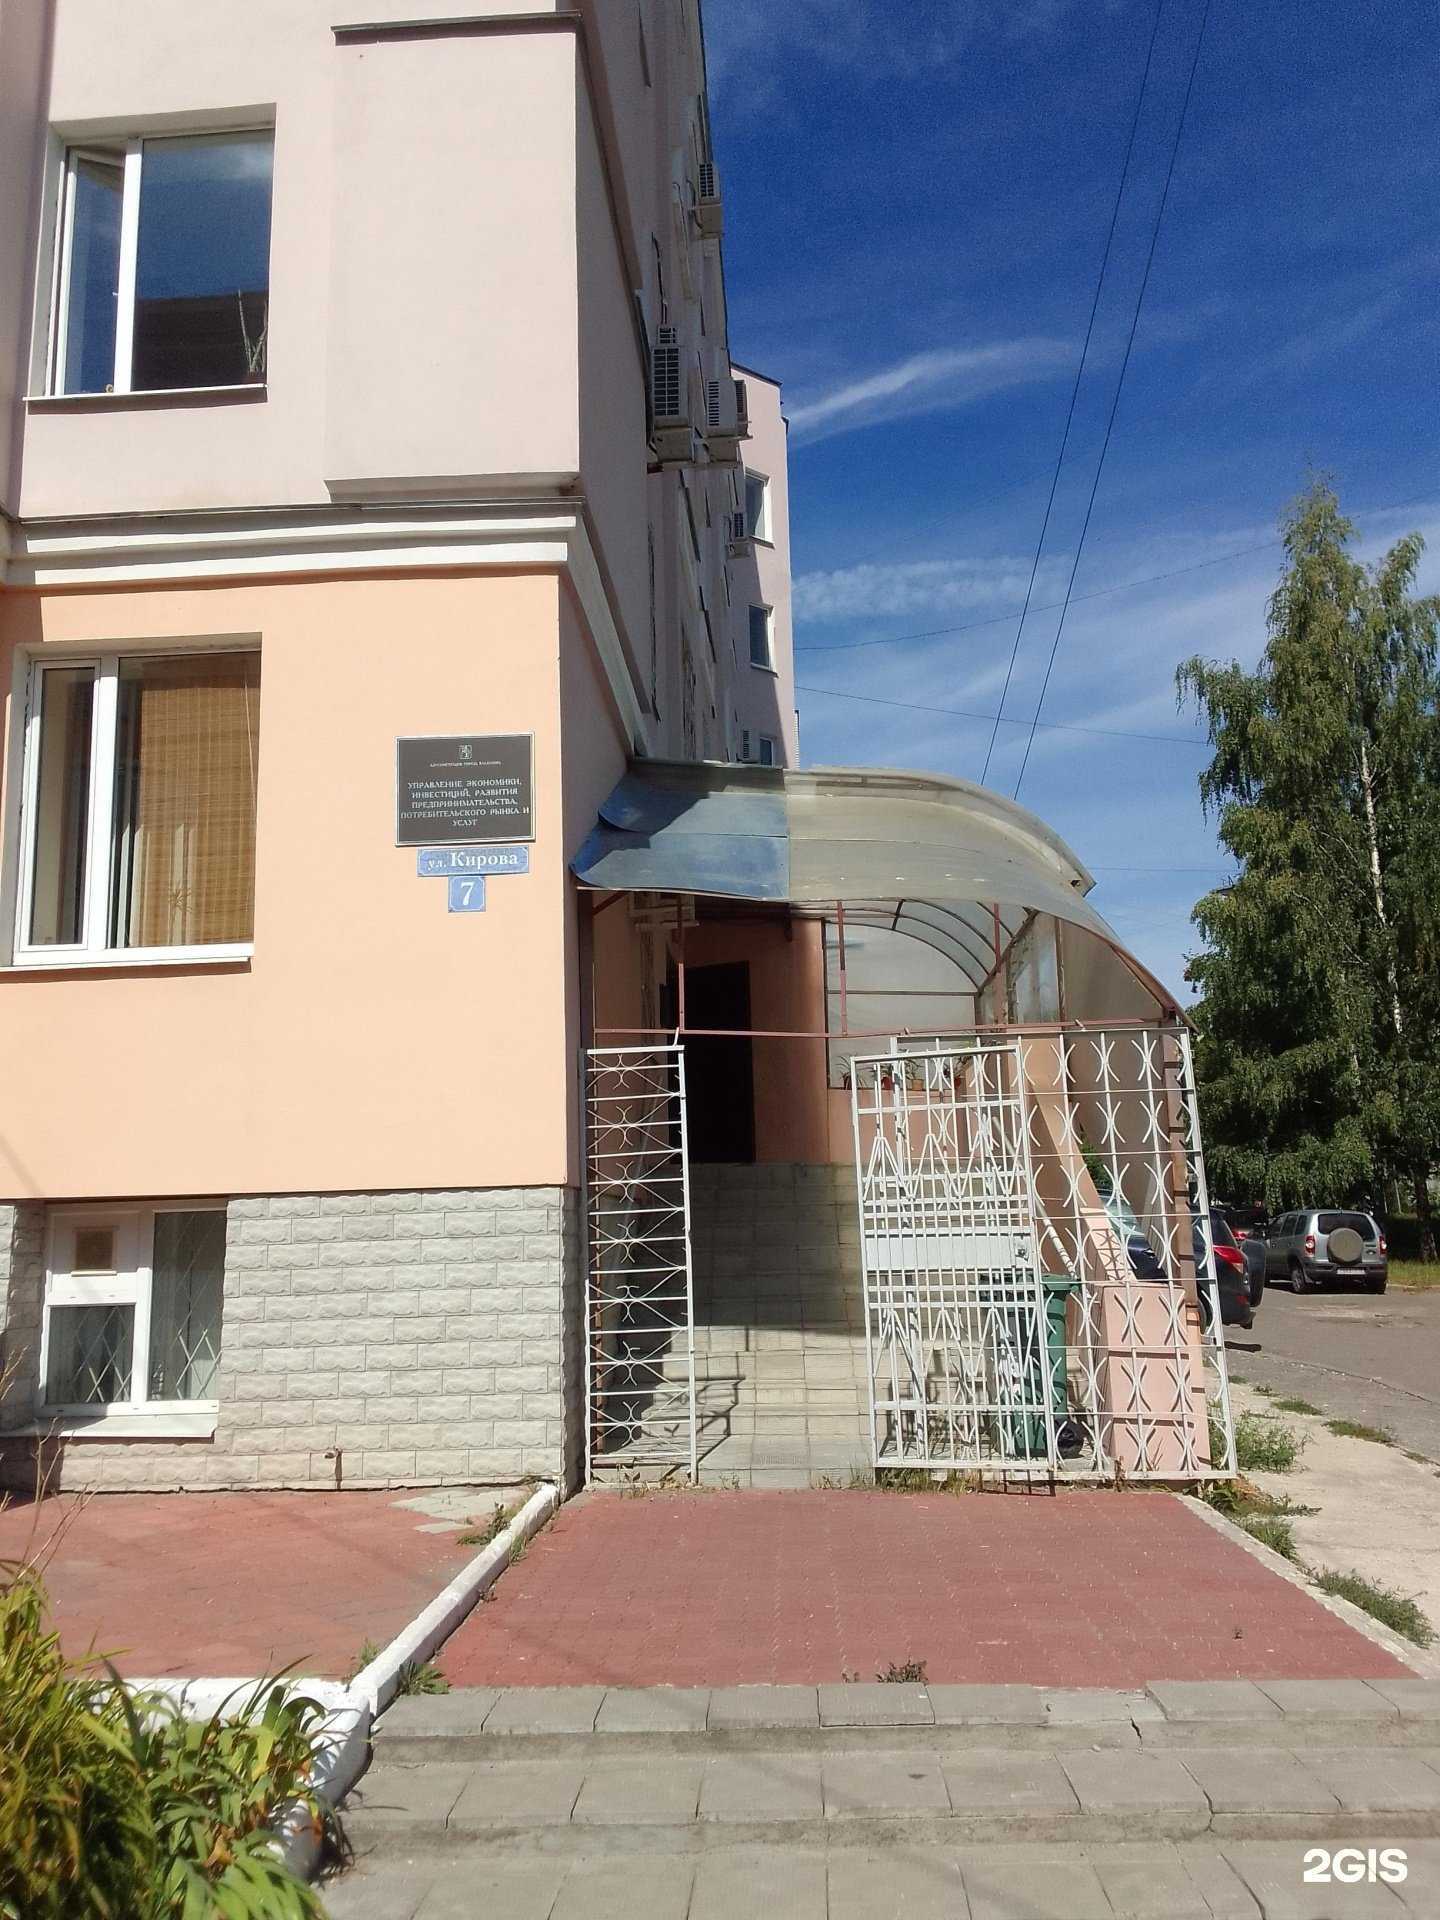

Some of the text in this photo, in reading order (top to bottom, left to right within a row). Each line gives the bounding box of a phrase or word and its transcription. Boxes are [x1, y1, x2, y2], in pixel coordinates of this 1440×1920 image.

[407, 781, 463, 790] УПРАВЛЕНИЕ
[474, 787, 518, 797] РАЗВИТИЯ
[400, 808, 487, 819] ПОТРЕБИТЕЛЬСКОГО
[522, 806, 530, 814] И
[428, 851, 518, 871] ул. Кирова
[460, 881, 475, 906] 7
